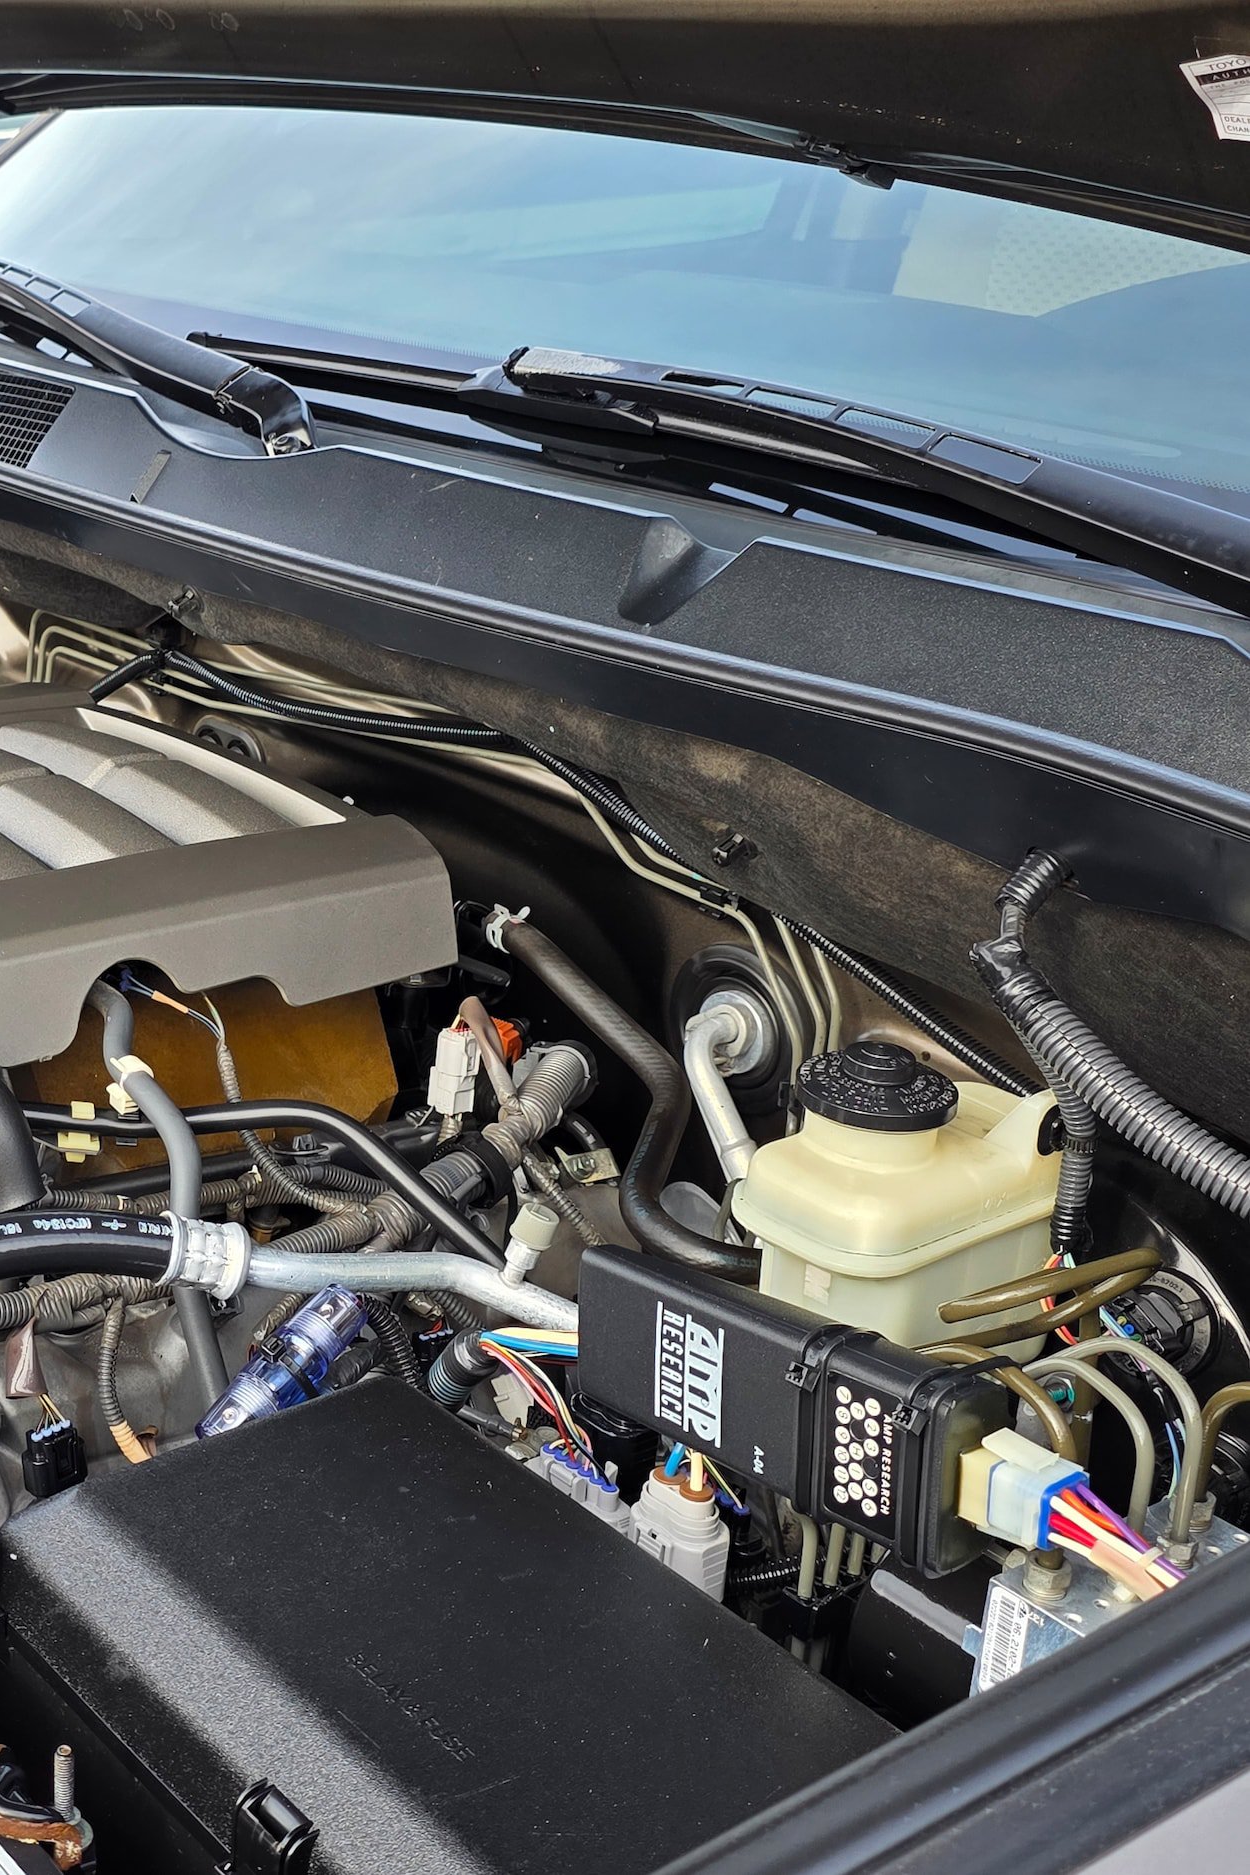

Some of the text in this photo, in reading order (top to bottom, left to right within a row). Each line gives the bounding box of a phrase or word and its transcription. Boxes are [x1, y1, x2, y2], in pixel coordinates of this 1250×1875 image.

[661, 1309, 685, 1427] RESEARCH
[753, 1445, 765, 1475] A-04
[880, 1413, 893, 1516] AMP RESEARCH
